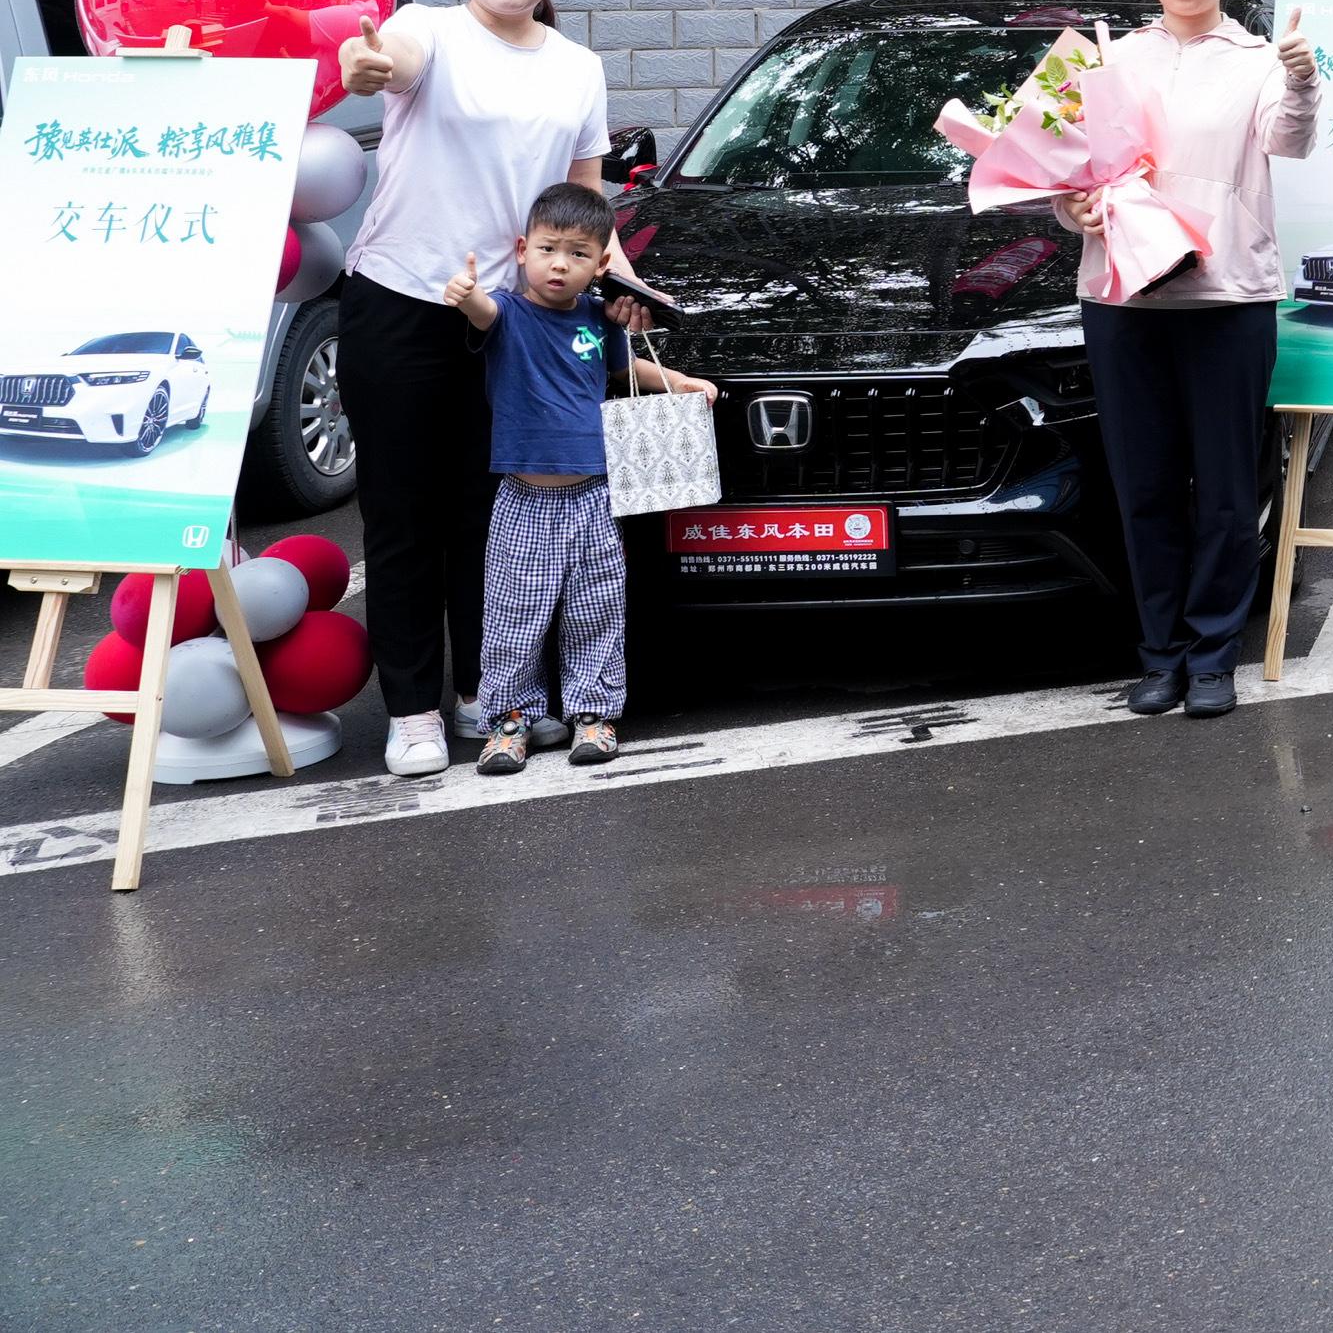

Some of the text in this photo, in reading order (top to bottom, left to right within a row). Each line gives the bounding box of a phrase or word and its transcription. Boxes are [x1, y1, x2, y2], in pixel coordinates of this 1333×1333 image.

[24, 118, 283, 165] 豫见英仕派 粽享风雅集
[45, 200, 219, 245] 交车仪式
[682, 522, 834, 541] 威佳东风本田
